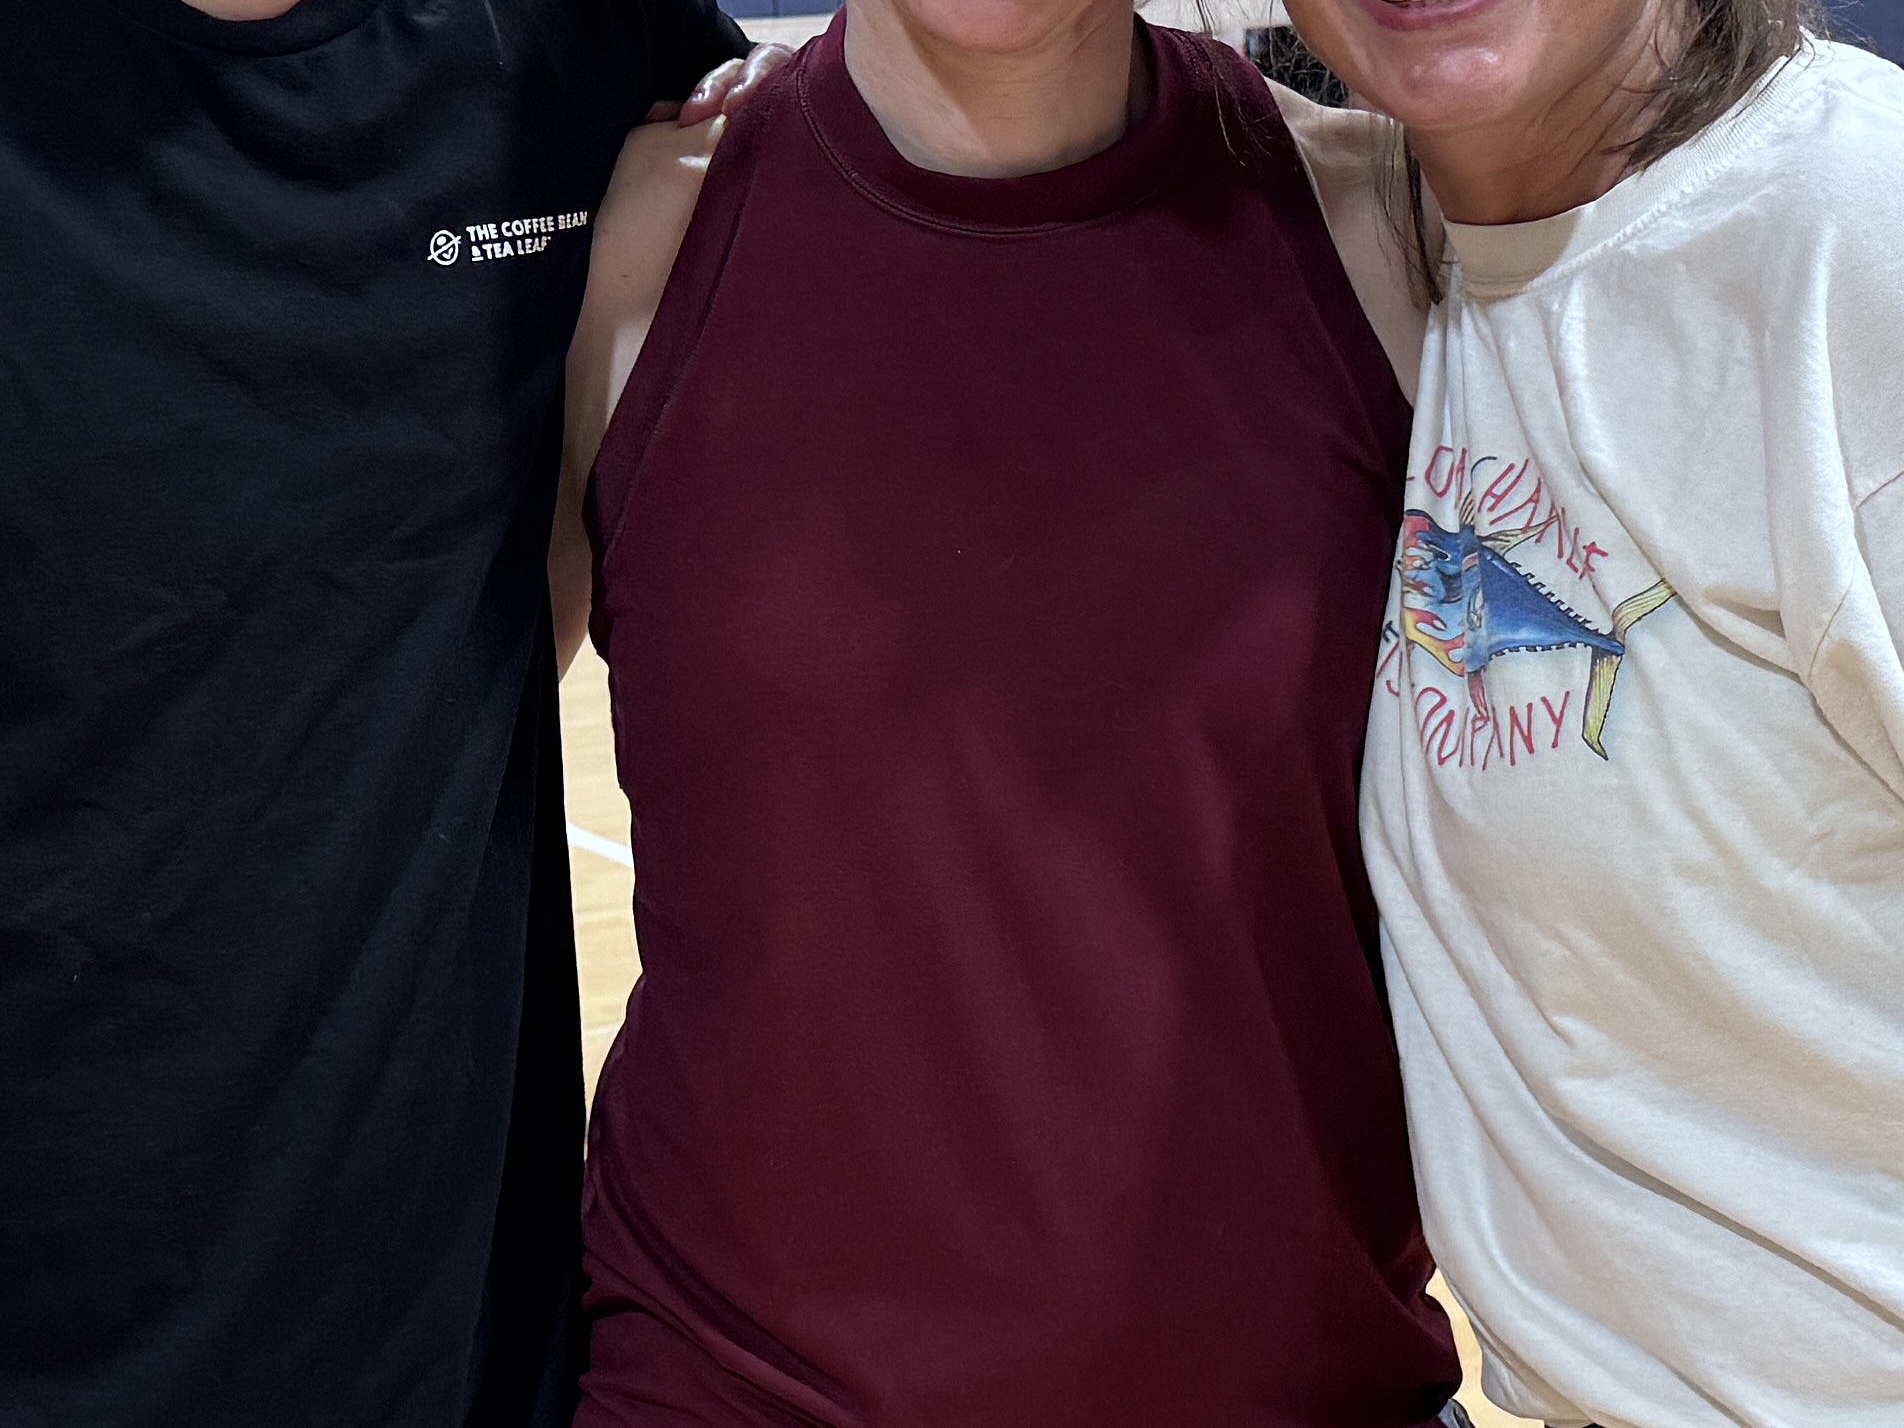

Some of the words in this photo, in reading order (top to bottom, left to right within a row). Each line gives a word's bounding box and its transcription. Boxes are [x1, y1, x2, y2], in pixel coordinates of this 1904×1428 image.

[466, 224, 498, 242] THE
[501, 216, 555, 237] COFFEE
[558, 211, 588, 230] BEAN
[482, 242, 514, 260] TEA
[517, 236, 549, 255] LEAF
